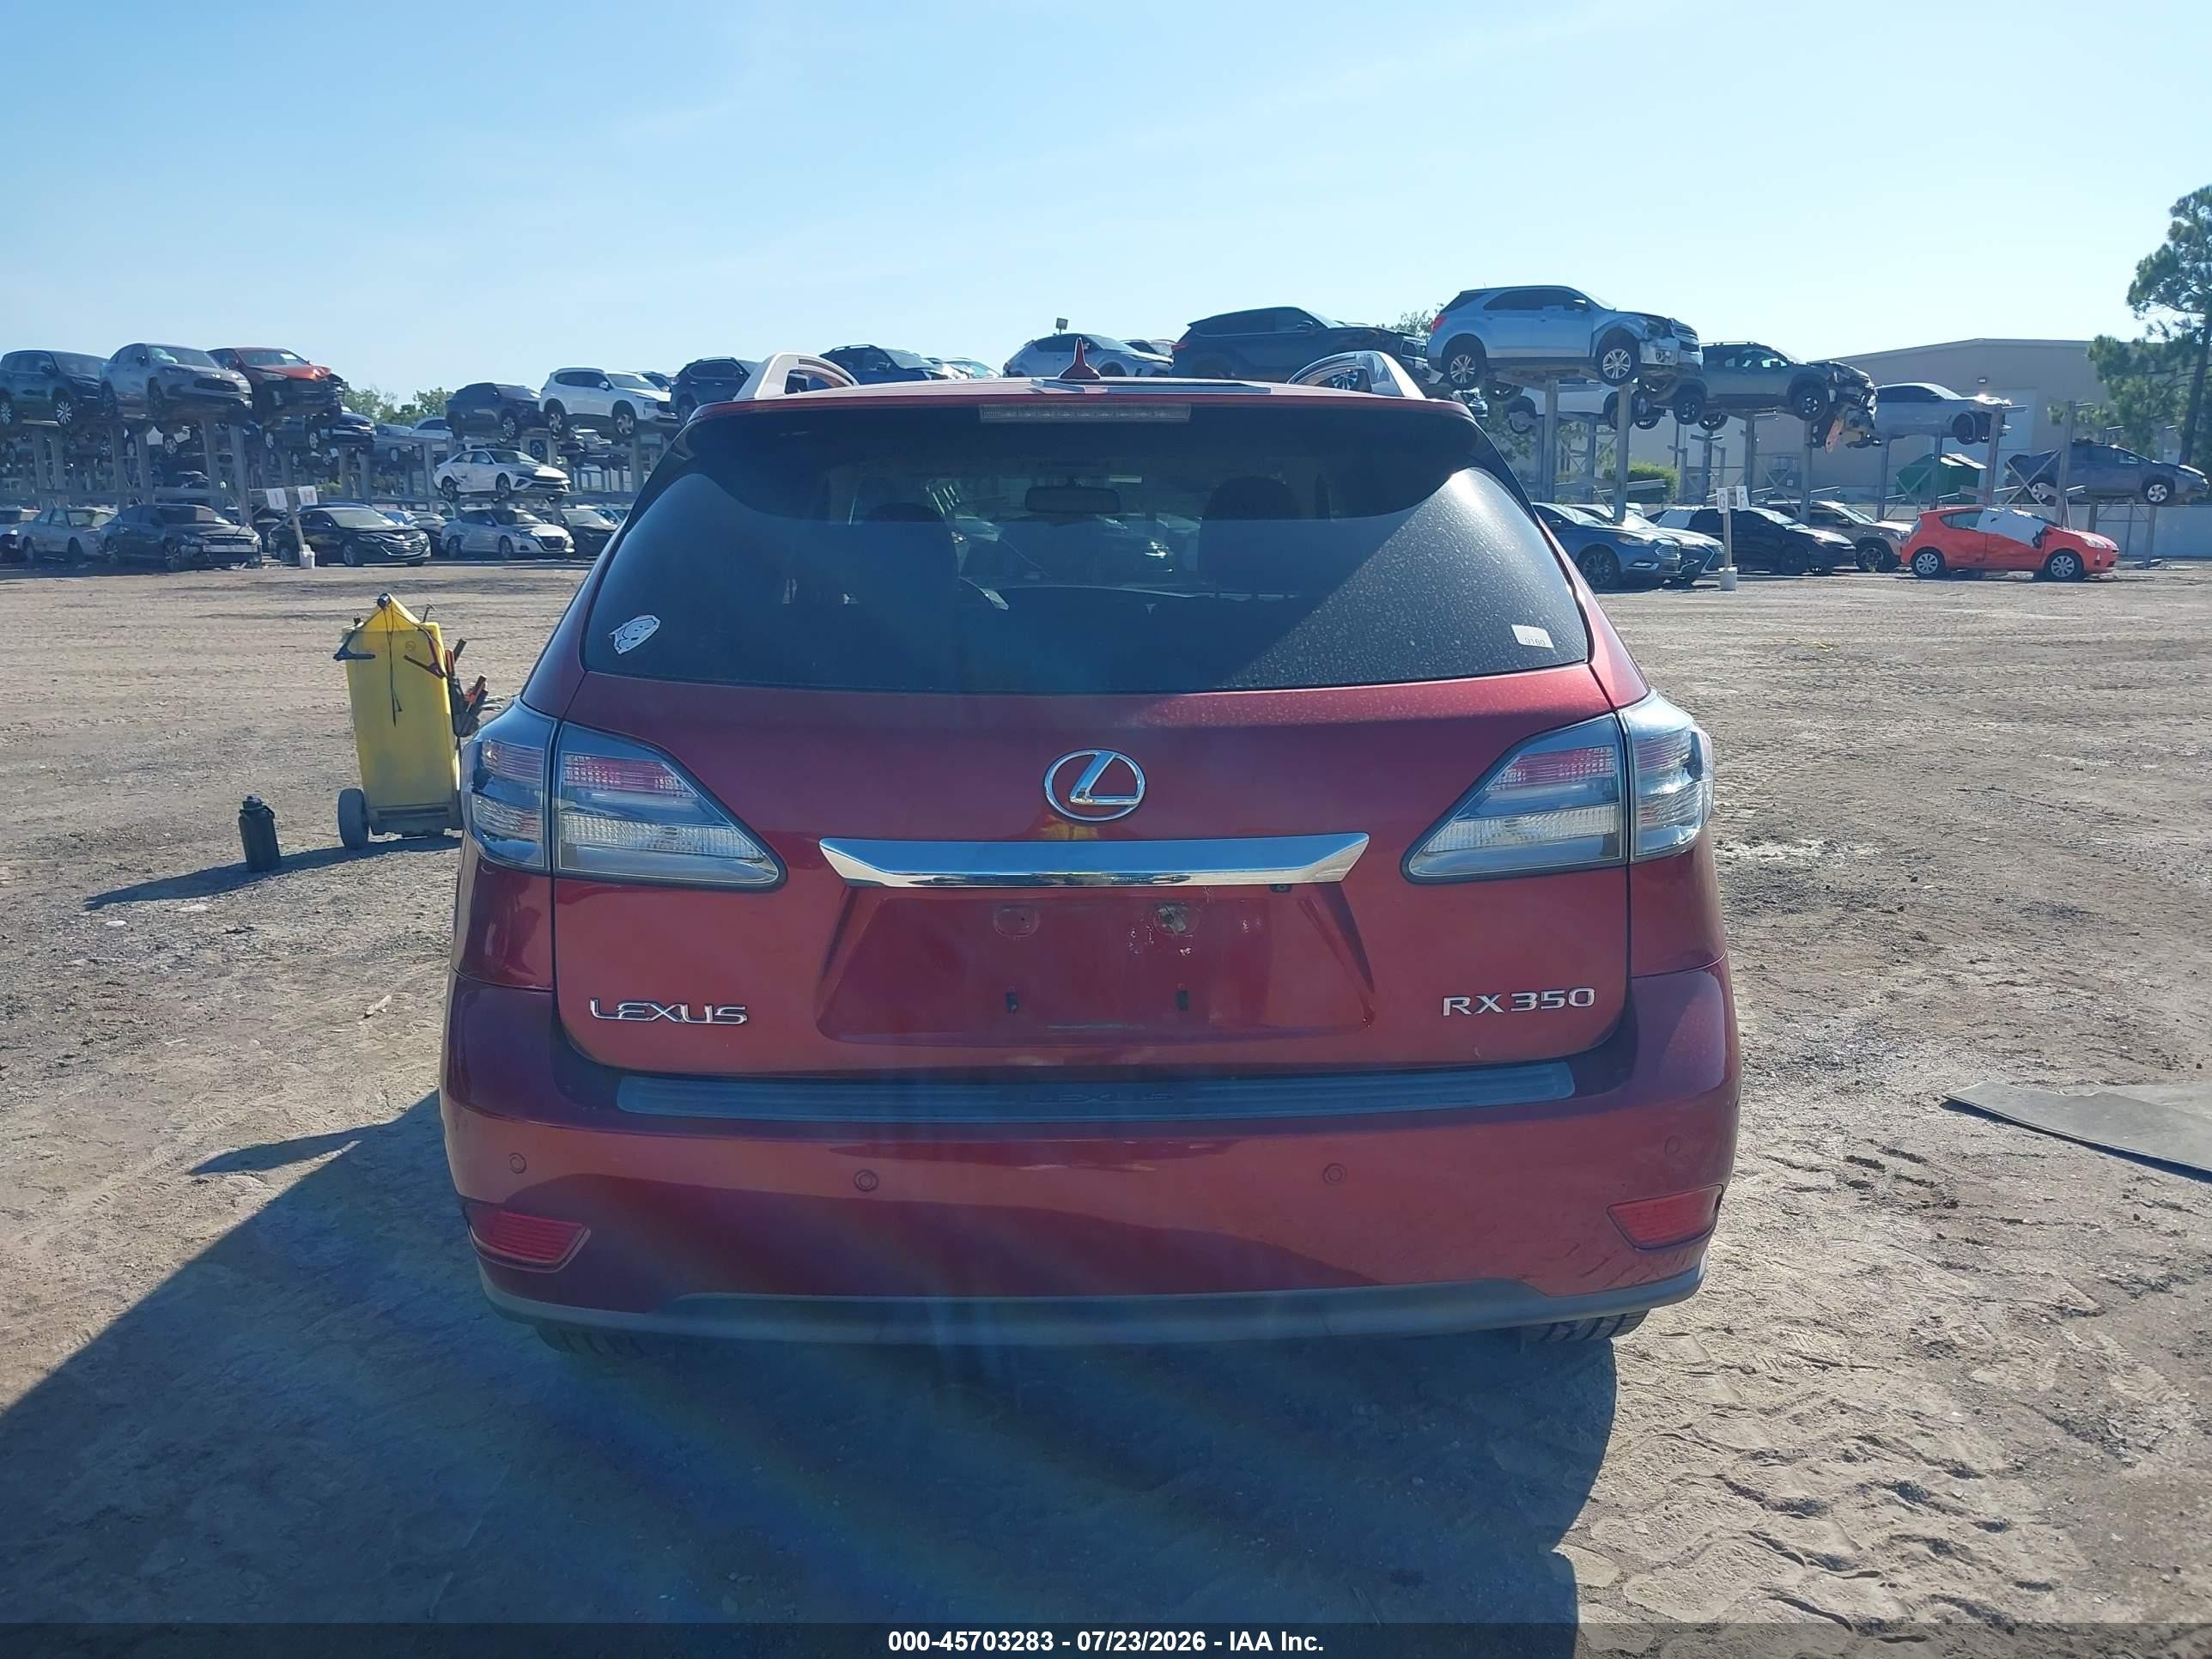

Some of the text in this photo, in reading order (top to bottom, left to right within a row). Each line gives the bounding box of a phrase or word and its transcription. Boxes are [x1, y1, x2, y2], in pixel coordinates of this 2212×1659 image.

[1718, 493, 1726, 509] G
[1740, 491, 1745, 508] F
[589, 998, 748, 1024] LEXUS
[1442, 988, 1595, 1017] RX 350
